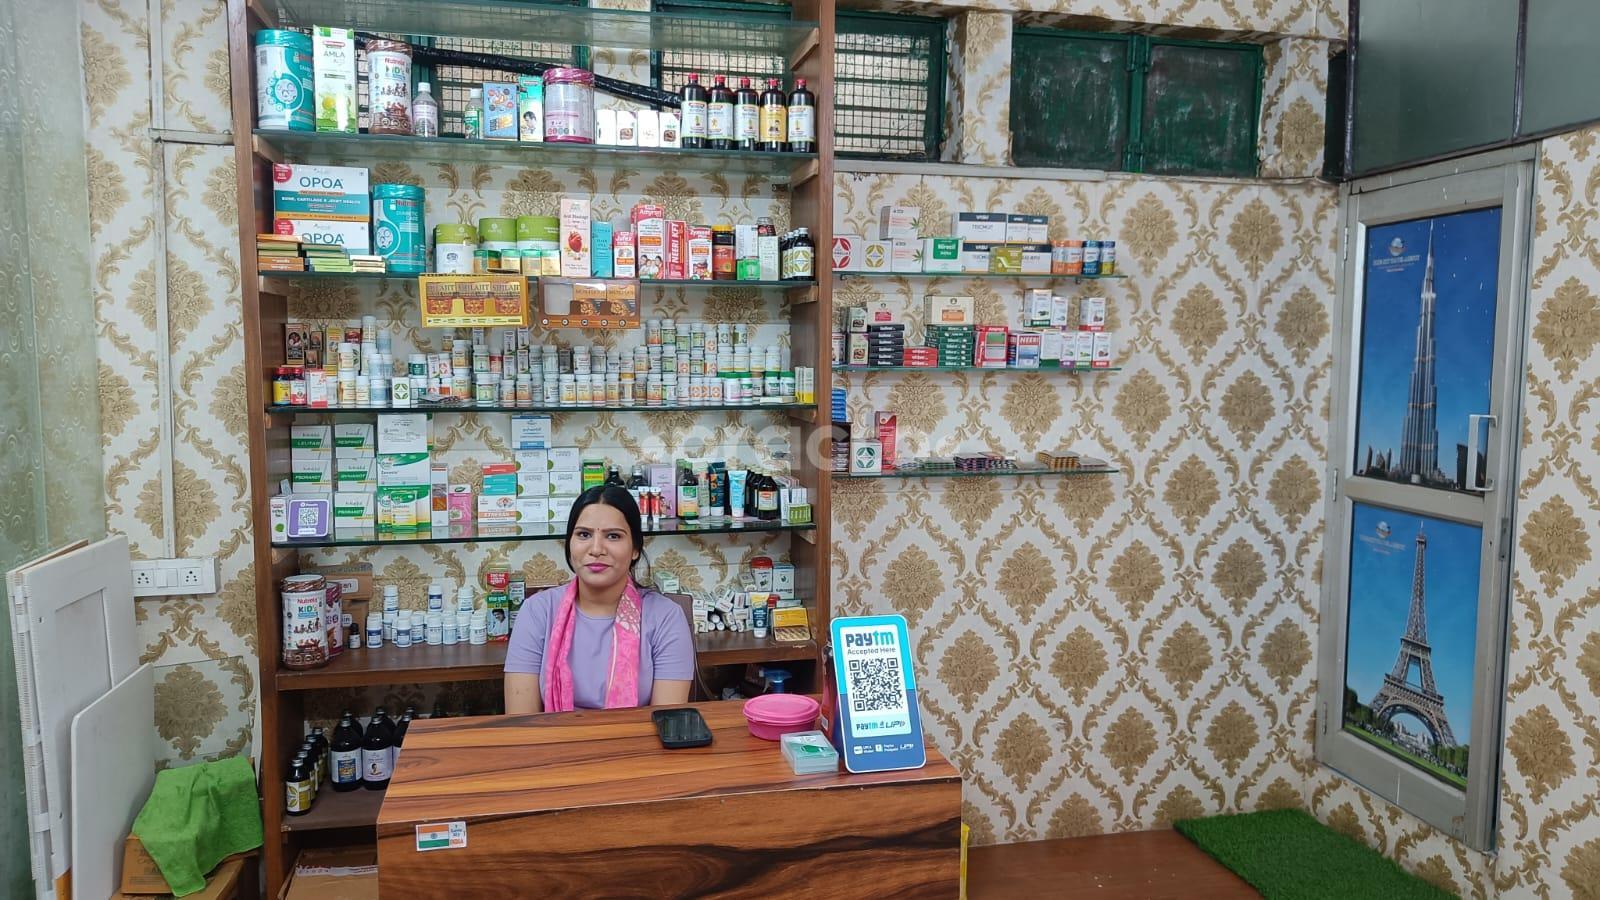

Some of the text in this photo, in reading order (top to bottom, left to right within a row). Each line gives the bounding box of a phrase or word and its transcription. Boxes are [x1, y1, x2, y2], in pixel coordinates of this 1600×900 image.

[299, 176, 343, 189] OPOA
[301, 233, 344, 244] OPOA
[671, 239, 679, 264] NEERI
[845, 630, 895, 648] paytm
[847, 648, 879, 656] Accepted
